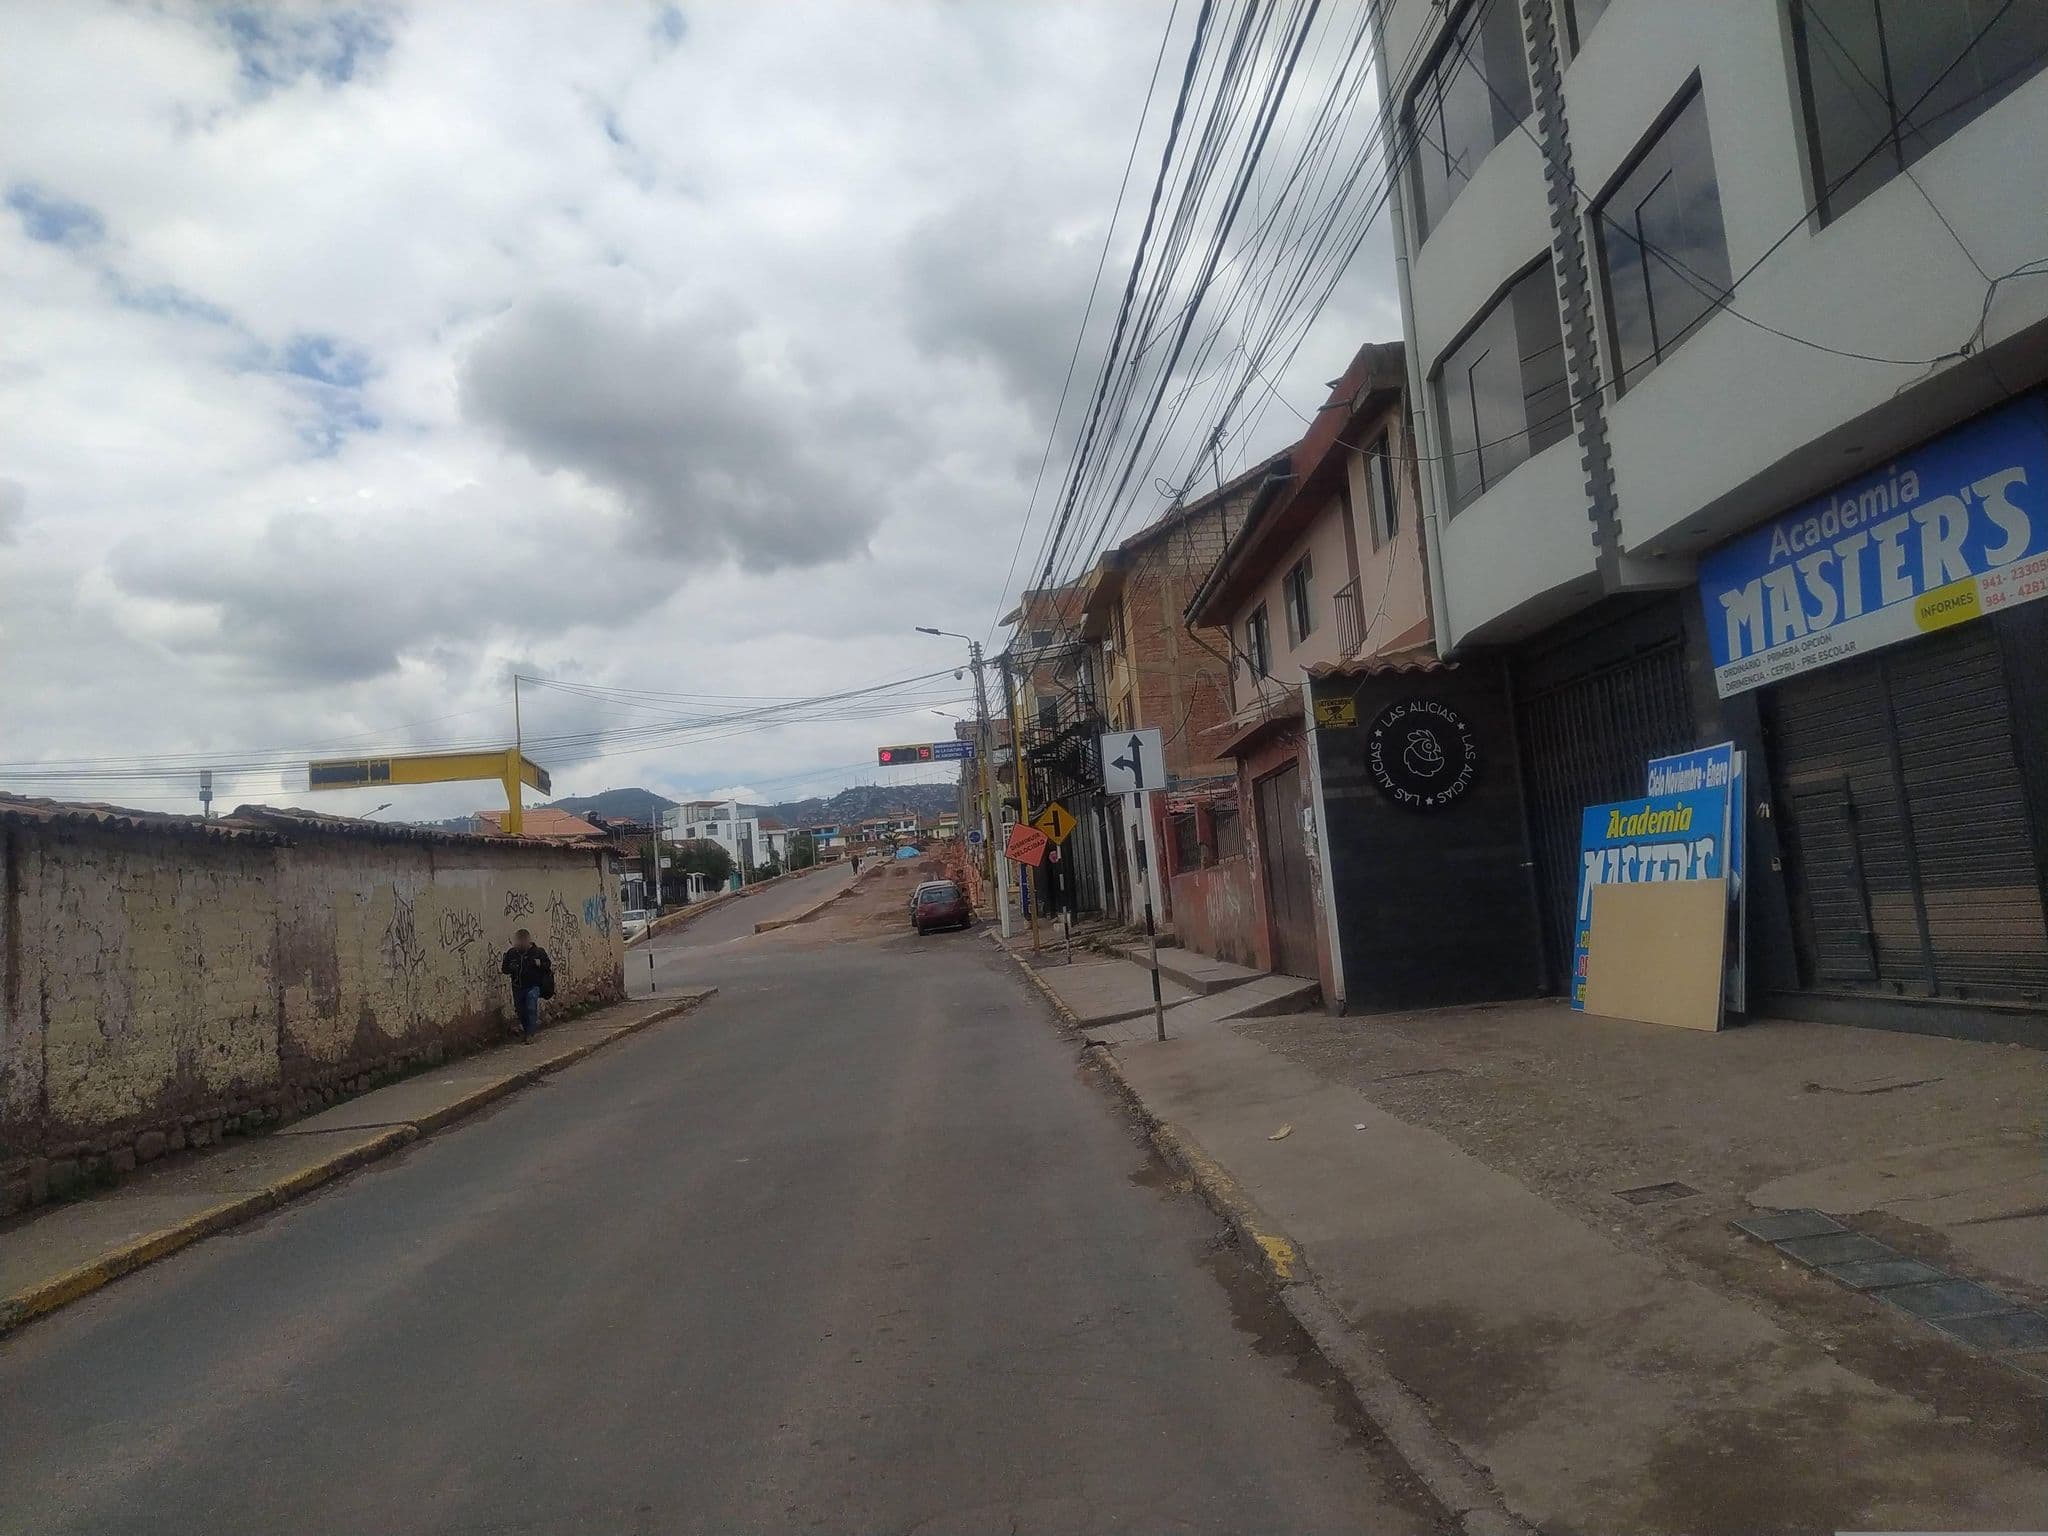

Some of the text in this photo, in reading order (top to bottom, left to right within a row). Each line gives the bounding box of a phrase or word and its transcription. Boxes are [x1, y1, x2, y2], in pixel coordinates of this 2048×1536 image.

[1769, 465, 1919, 565] Academia
[1719, 467, 2032, 662] MASTER'S
[2011, 558, 2048, 581] 23305
[1920, 593, 1974, 620] INFORMES
[1723, 658, 1761, 679] ORDINARIO
[1767, 646, 1800, 662] PRIMERA
[1726, 671, 1766, 691] DIRIMENCIA
[1770, 662, 1796, 677] CEPRU
[1802, 654, 1817, 667] PRE
[1818, 641, 1857, 660] ESCOLAR
[1381, 701, 1457, 727] LAS ALICIAS
[1370, 741, 1420, 806] LAS ALICIAS
[1437, 734, 1476, 804] LAS ALICIAS
[1706, 757, 1728, 788] Enero
[1606, 801, 1693, 839] Academia
[1011, 839, 1045, 858] VELOCIDAD
